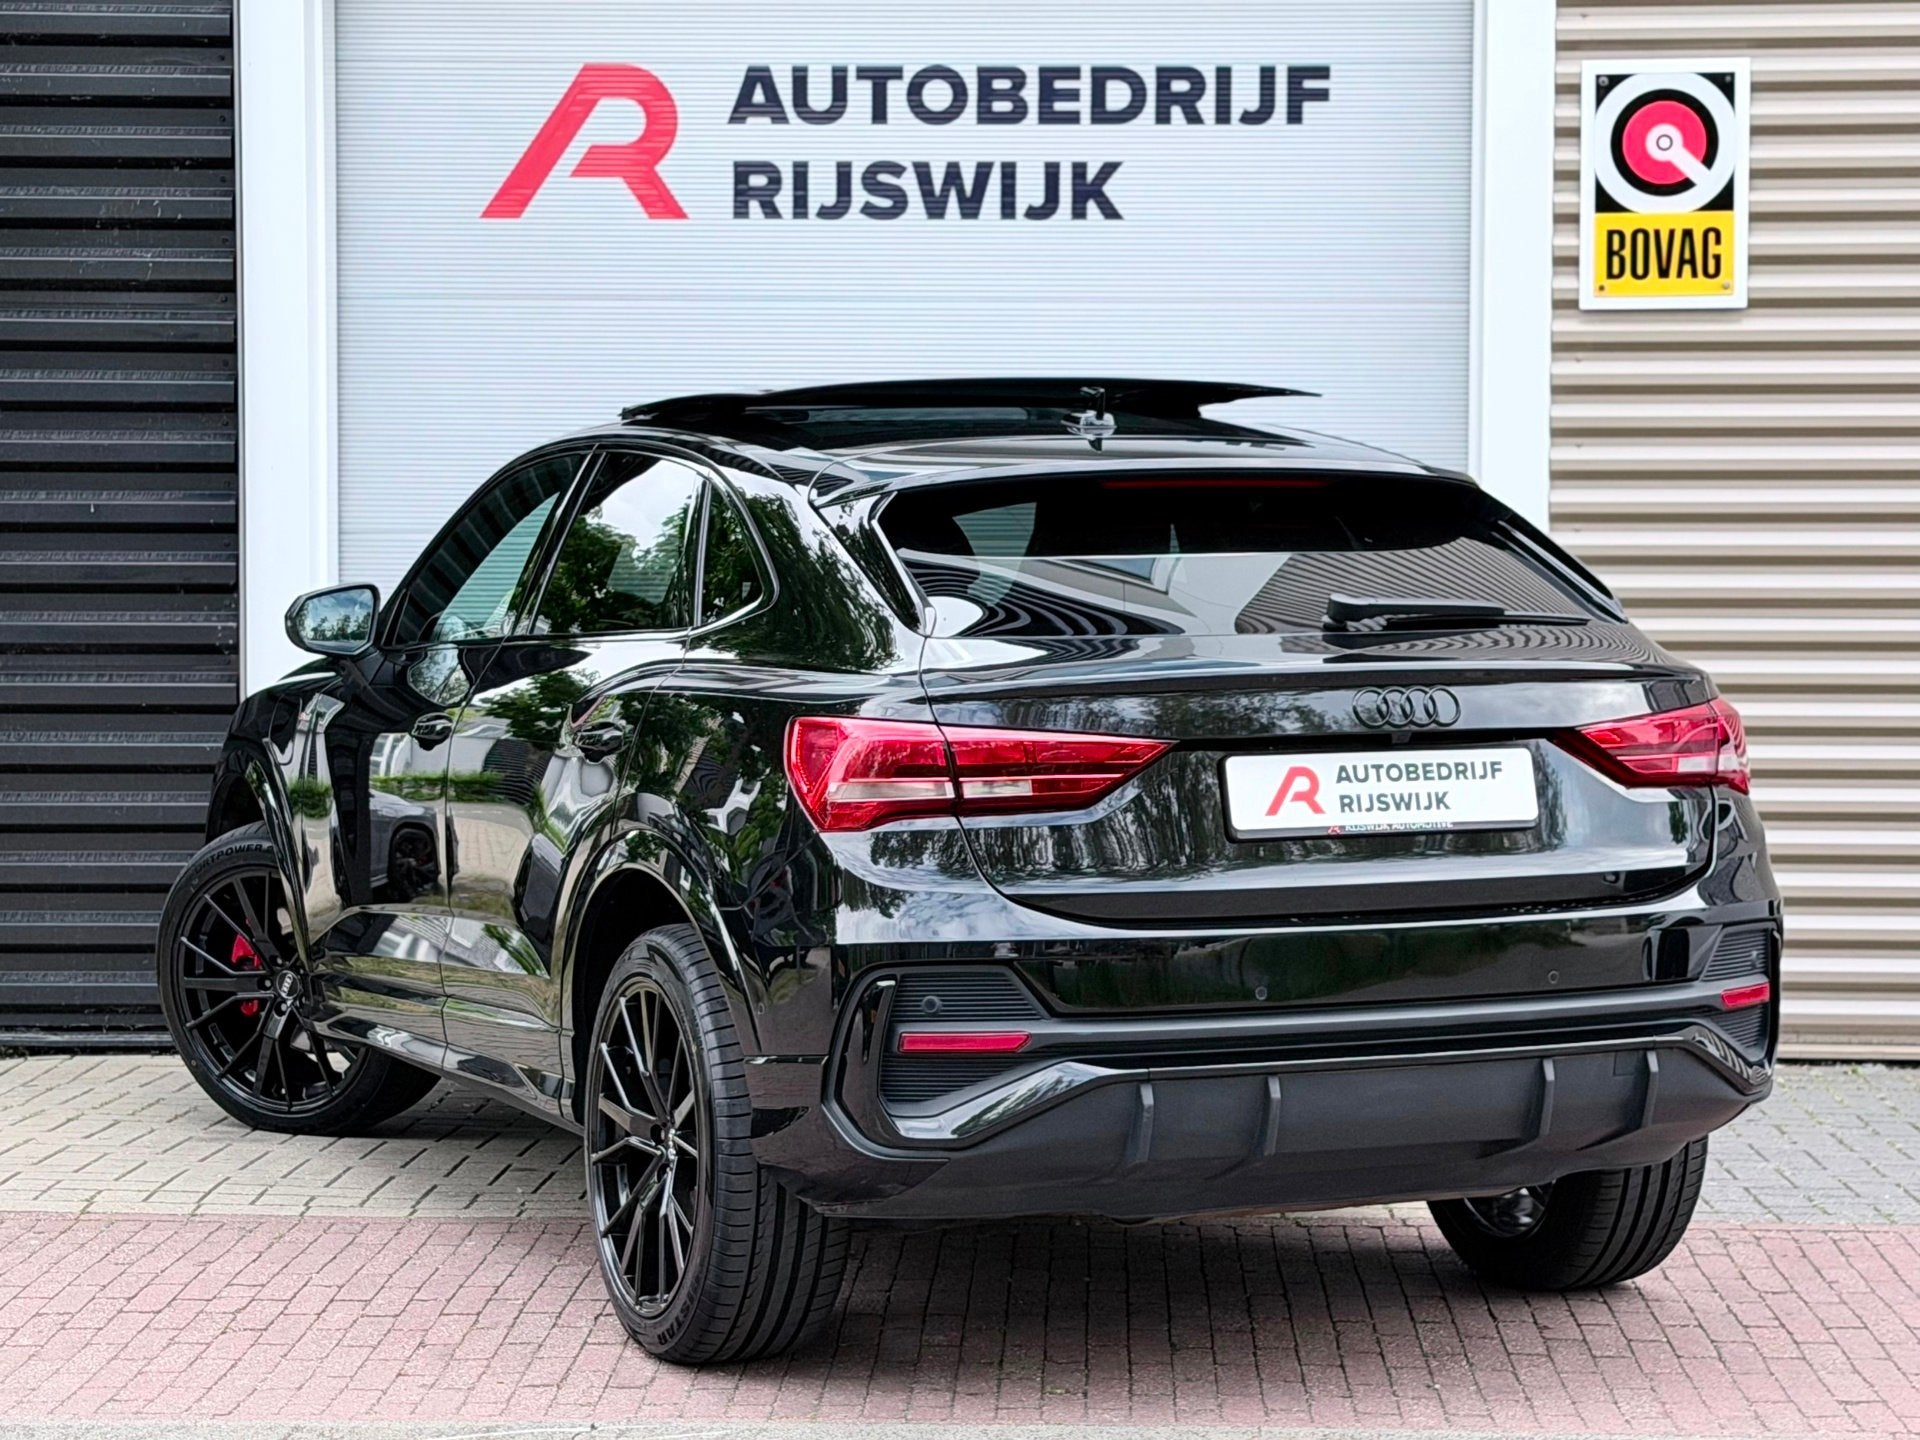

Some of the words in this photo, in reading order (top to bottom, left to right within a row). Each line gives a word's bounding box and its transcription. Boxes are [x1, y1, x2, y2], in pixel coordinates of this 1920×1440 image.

[728, 64, 1331, 126] AUTOBEDRIJF
[732, 160, 1124, 220] RIJSWIJK
[1606, 227, 1722, 280] BOVAG
[1336, 760, 1502, 784] AUTOBEDRIJF
[1339, 791, 1452, 814] RIJSWIJK
